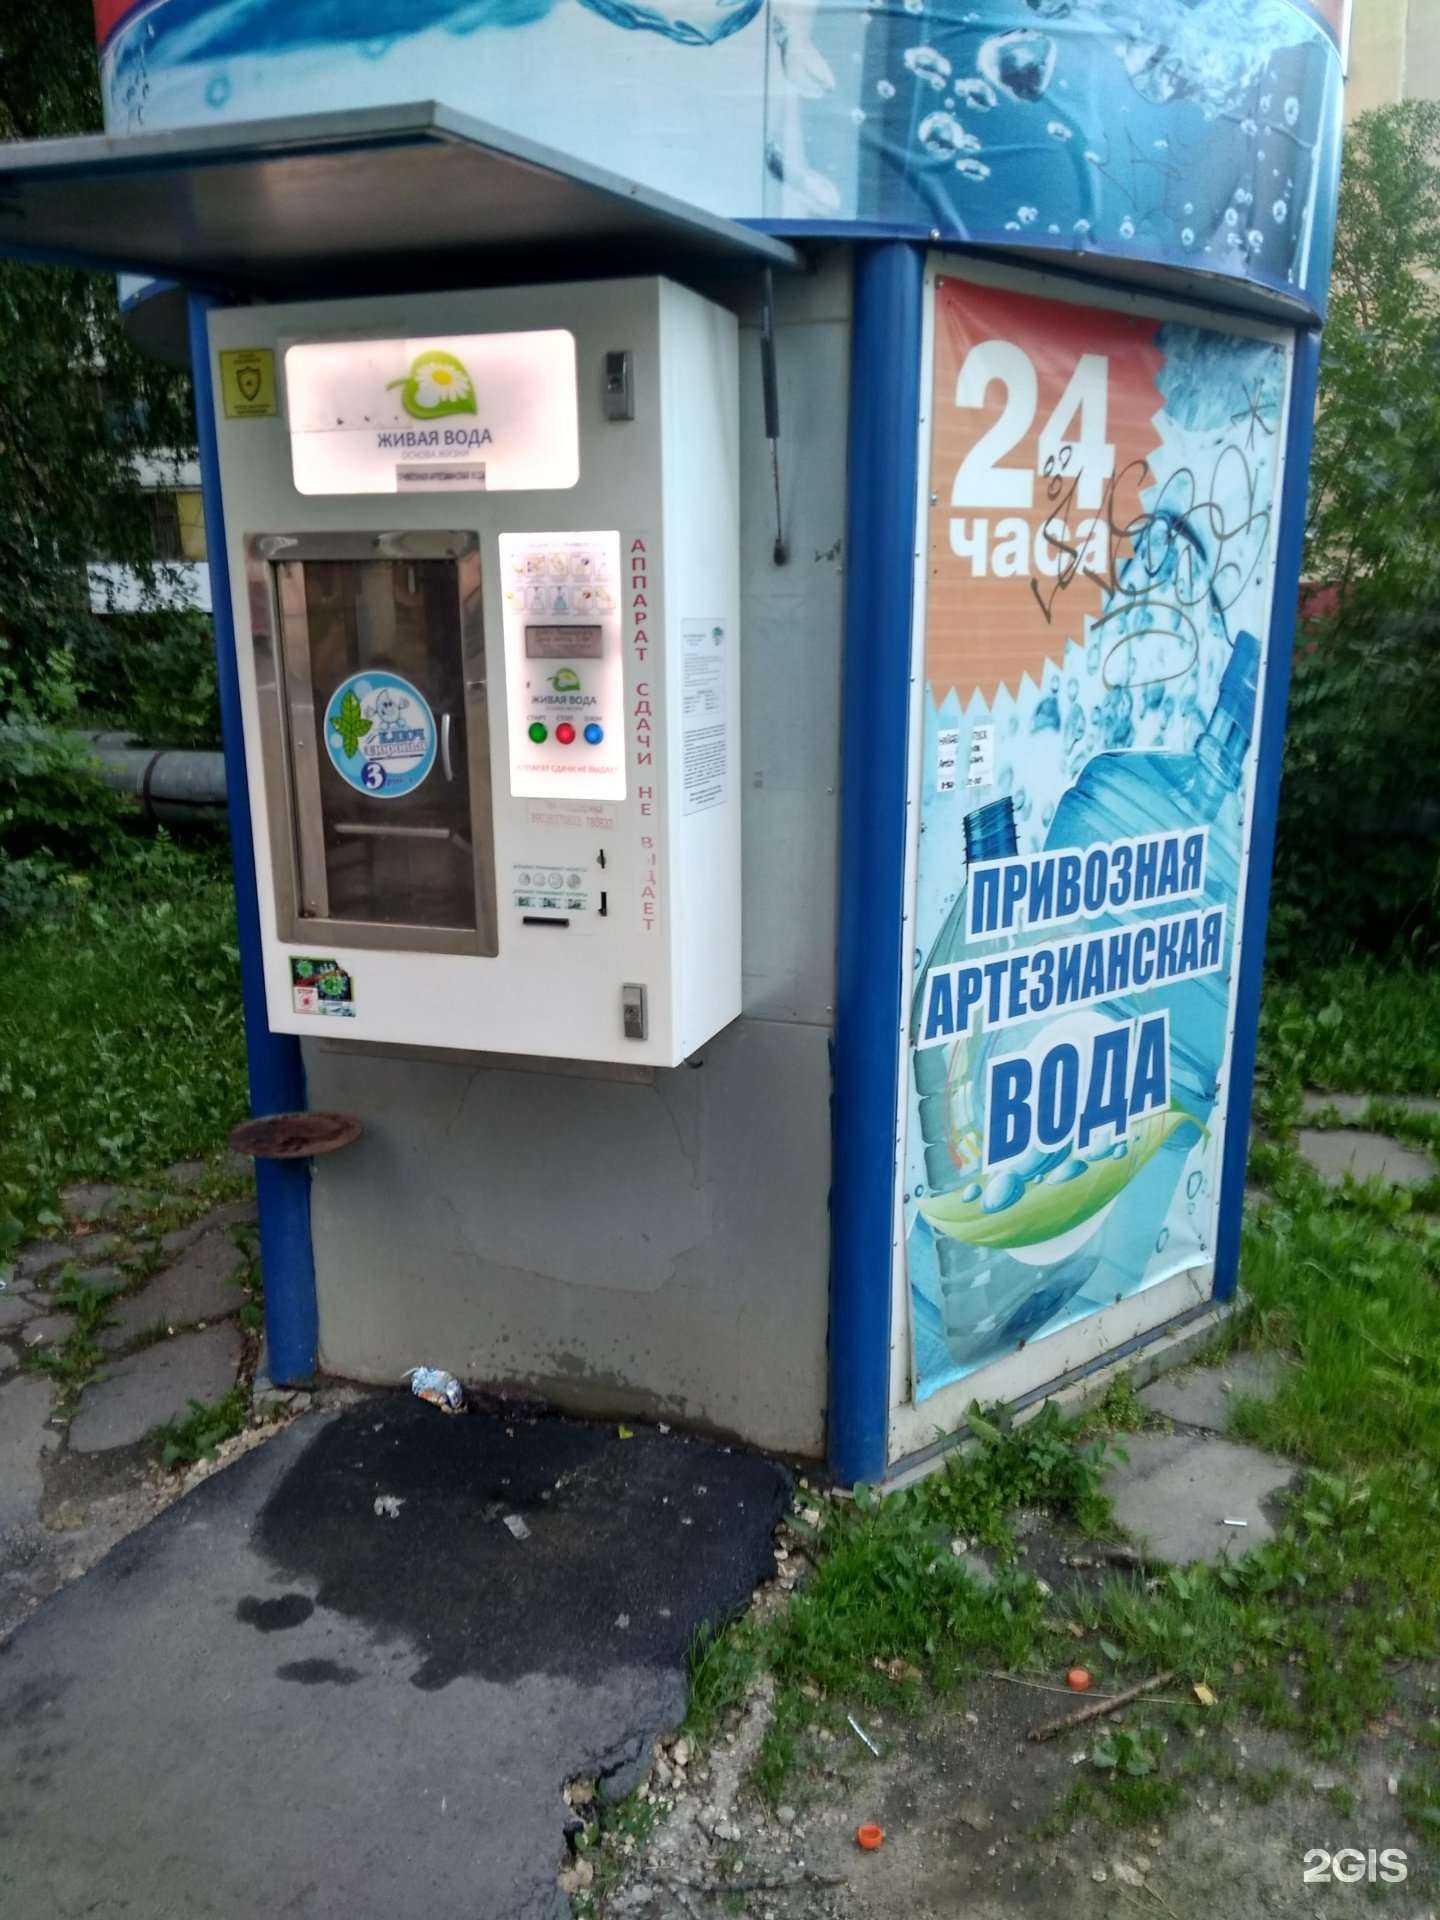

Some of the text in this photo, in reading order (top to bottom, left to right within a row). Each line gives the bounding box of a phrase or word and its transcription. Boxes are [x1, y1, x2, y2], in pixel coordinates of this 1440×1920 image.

[377, 428, 493, 448] ЖИВАЯ ВОДА
[950, 339, 1116, 510] 24
[949, 517, 1110, 578] часа
[531, 695, 597, 706] ЖИВАЯ ВОДА
[630, 538, 656, 931] АППАРАТ СДАЧИ НЕ ВАЕТ
[366, 761, 384, 790] 3
[969, 833, 1204, 936] ПРИВОЗНАЯ
[924, 912, 1222, 1041] АРТЕЗИАНСКАЯ
[987, 1017, 1166, 1166] ВОДА
